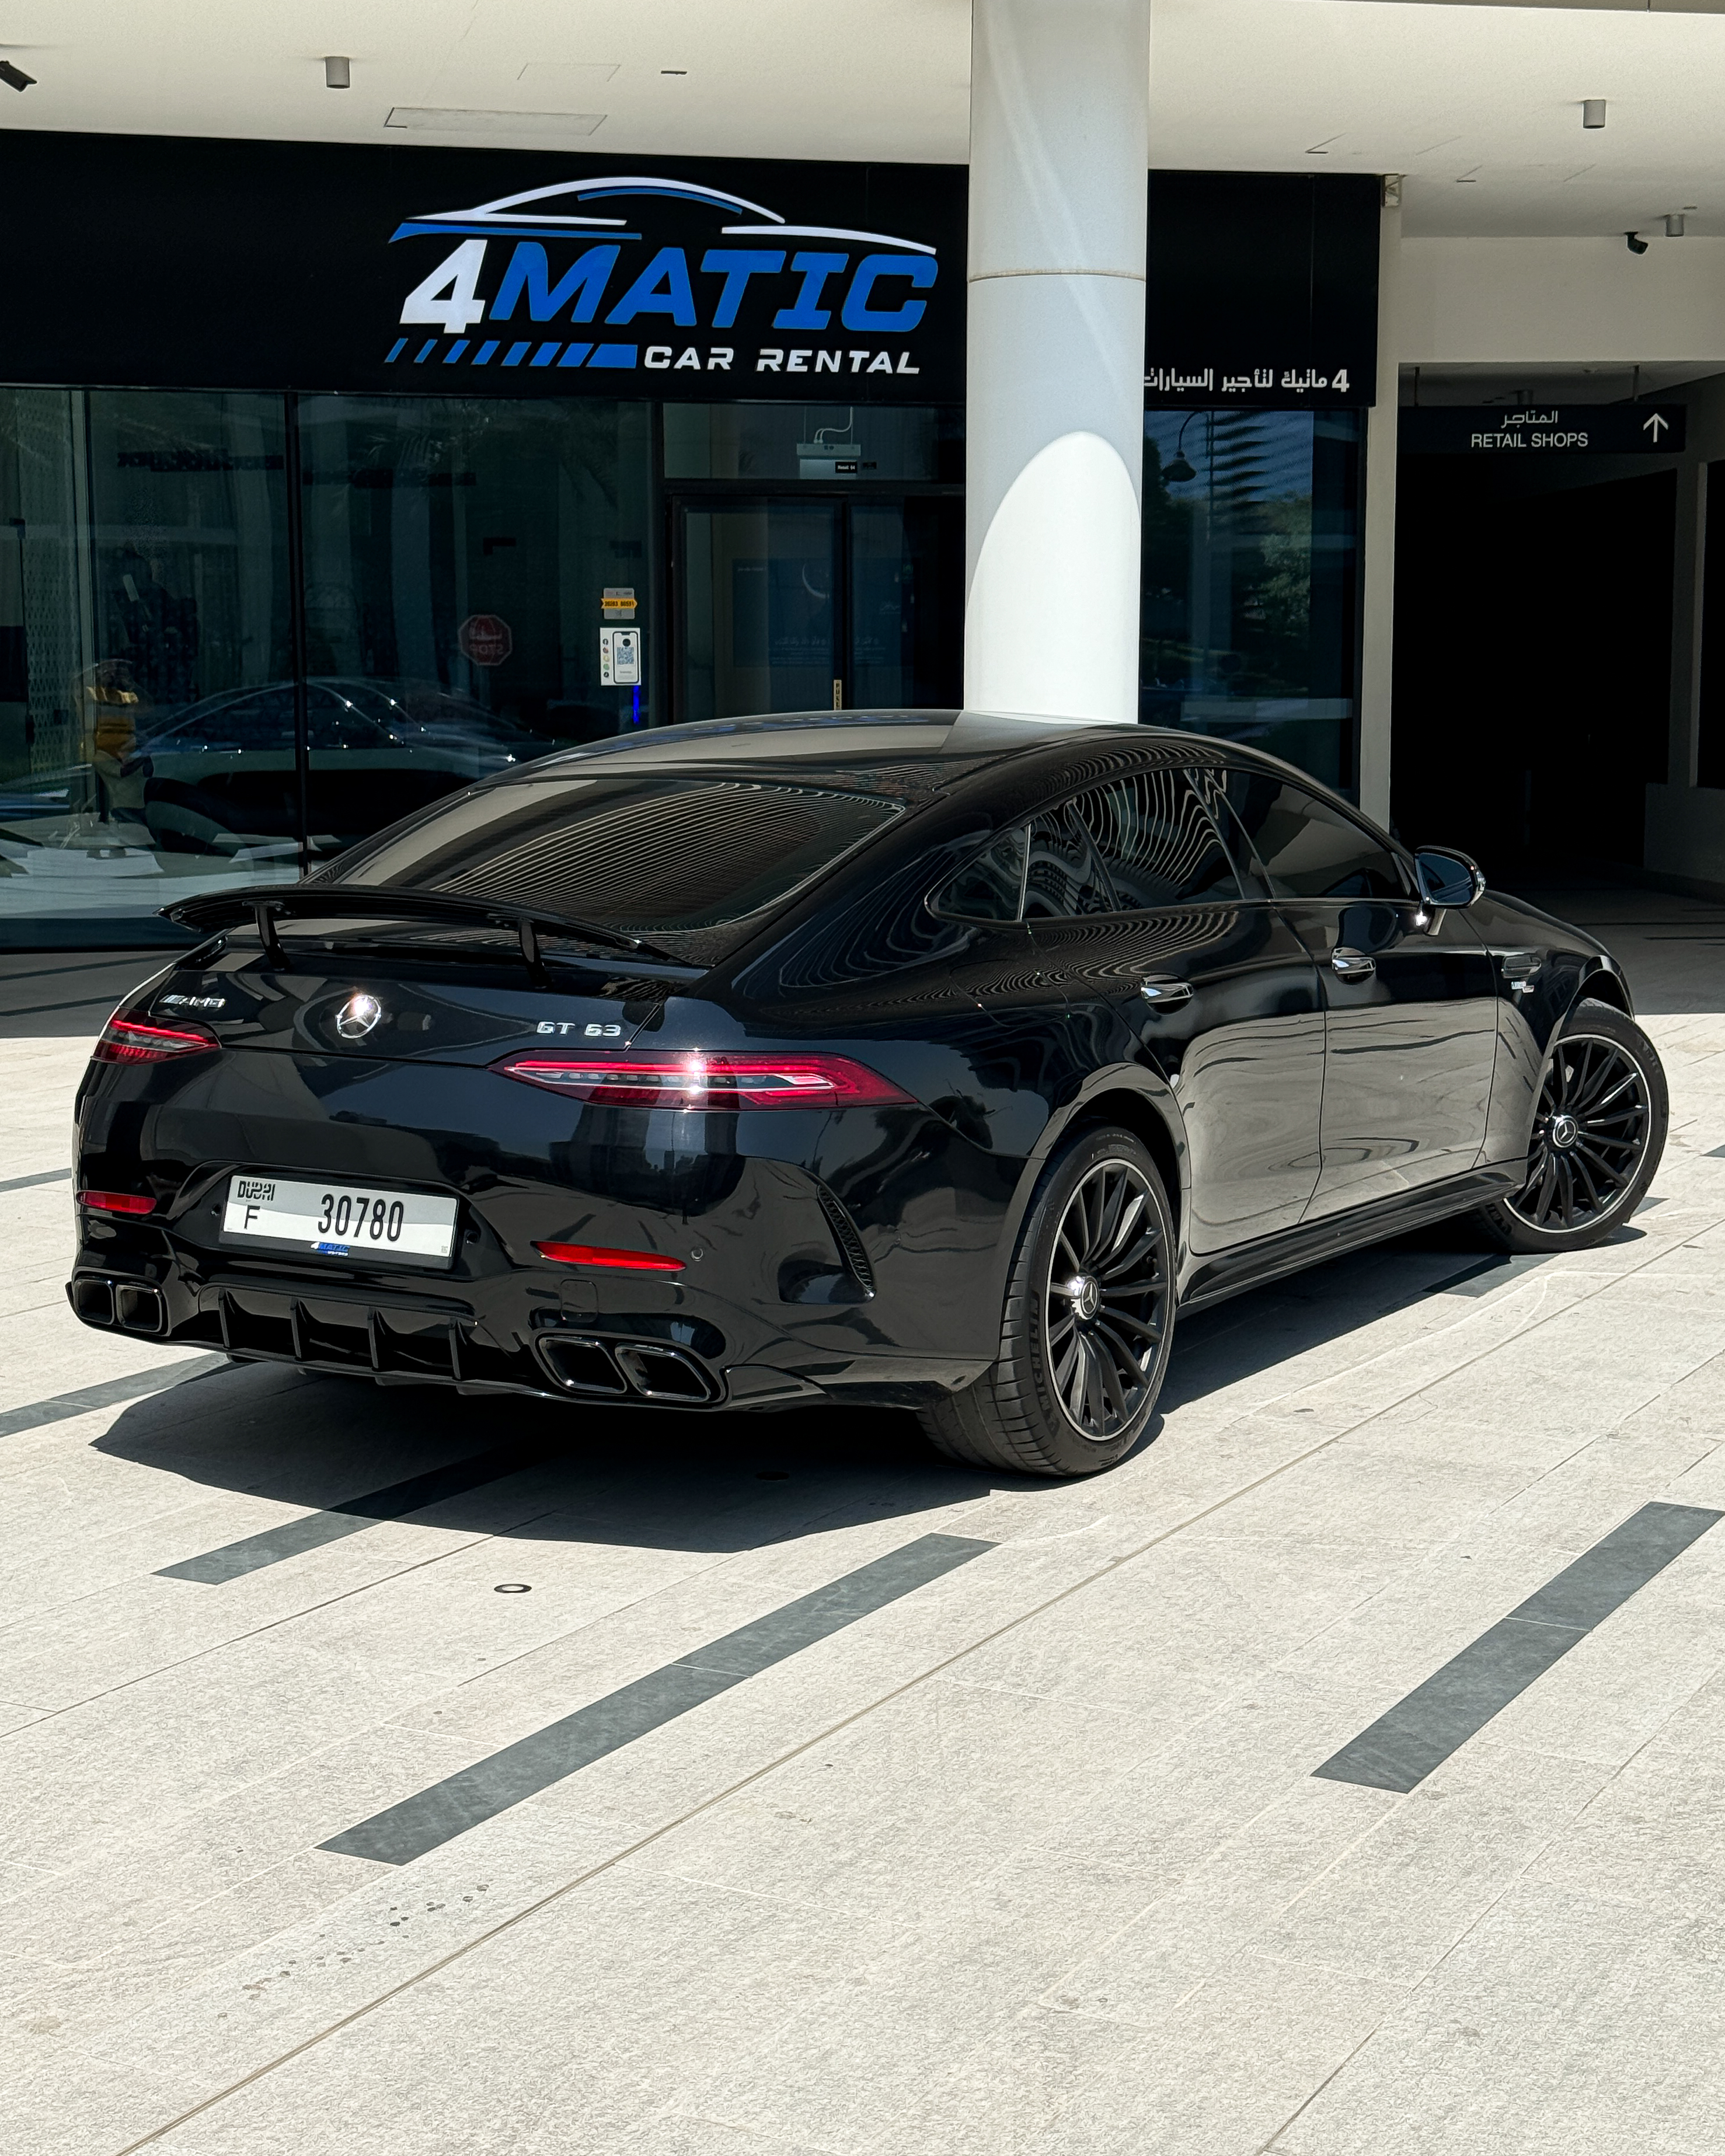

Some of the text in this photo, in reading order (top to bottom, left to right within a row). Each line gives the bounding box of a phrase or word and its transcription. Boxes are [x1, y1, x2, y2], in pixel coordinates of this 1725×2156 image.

[399, 239, 938, 334] 4MATIC
[644, 346, 920, 374] CAR RENTAL
[1500, 410, 1559, 429] المتاجر
[1471, 432, 1588, 448] RETAIL SHOPS
[536, 1021, 621, 1037] GT 63
[244, 1205, 260, 1230] F
[318, 1194, 404, 1242] 30780
[1030, 1297, 1051, 1412] MICHELIN
